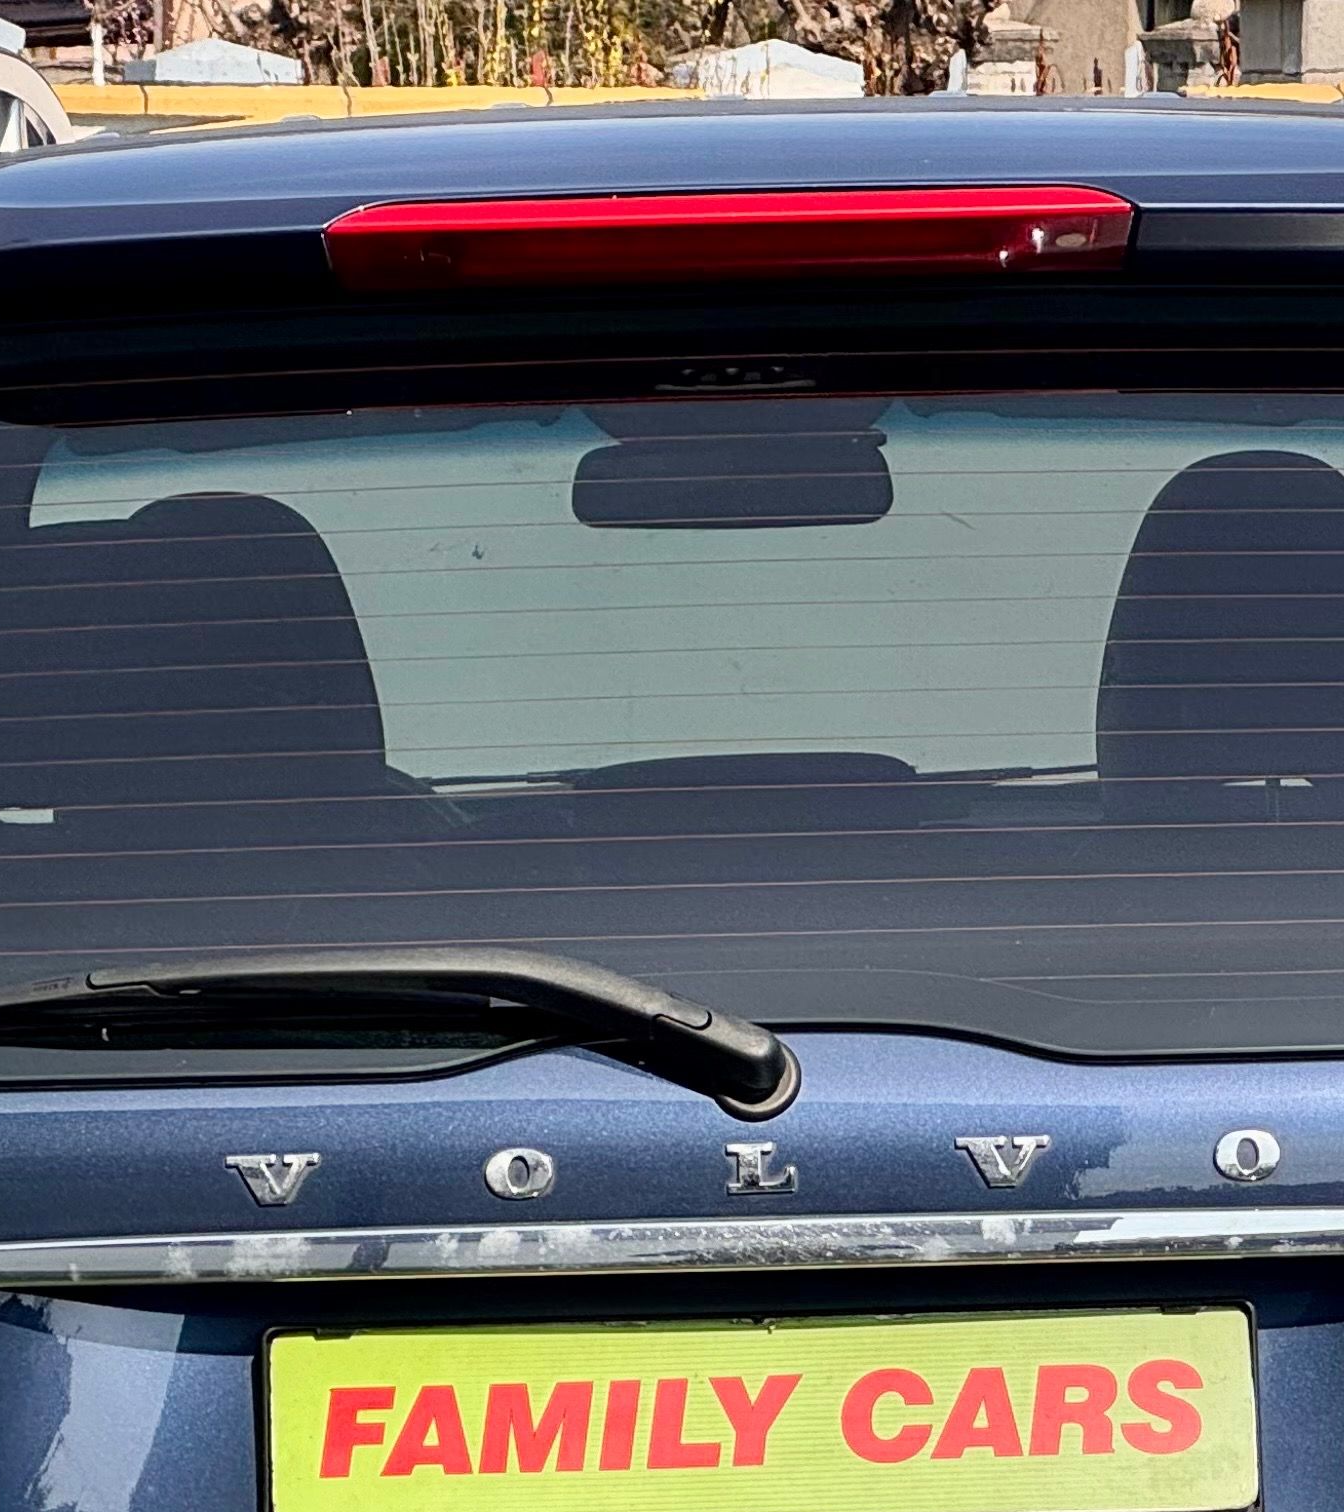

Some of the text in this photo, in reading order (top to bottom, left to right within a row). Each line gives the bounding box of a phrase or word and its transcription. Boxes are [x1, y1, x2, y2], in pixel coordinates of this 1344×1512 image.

[224, 1128, 1282, 1207] VOLVO
[320, 1360, 1201, 1479] FAMILY CARS
